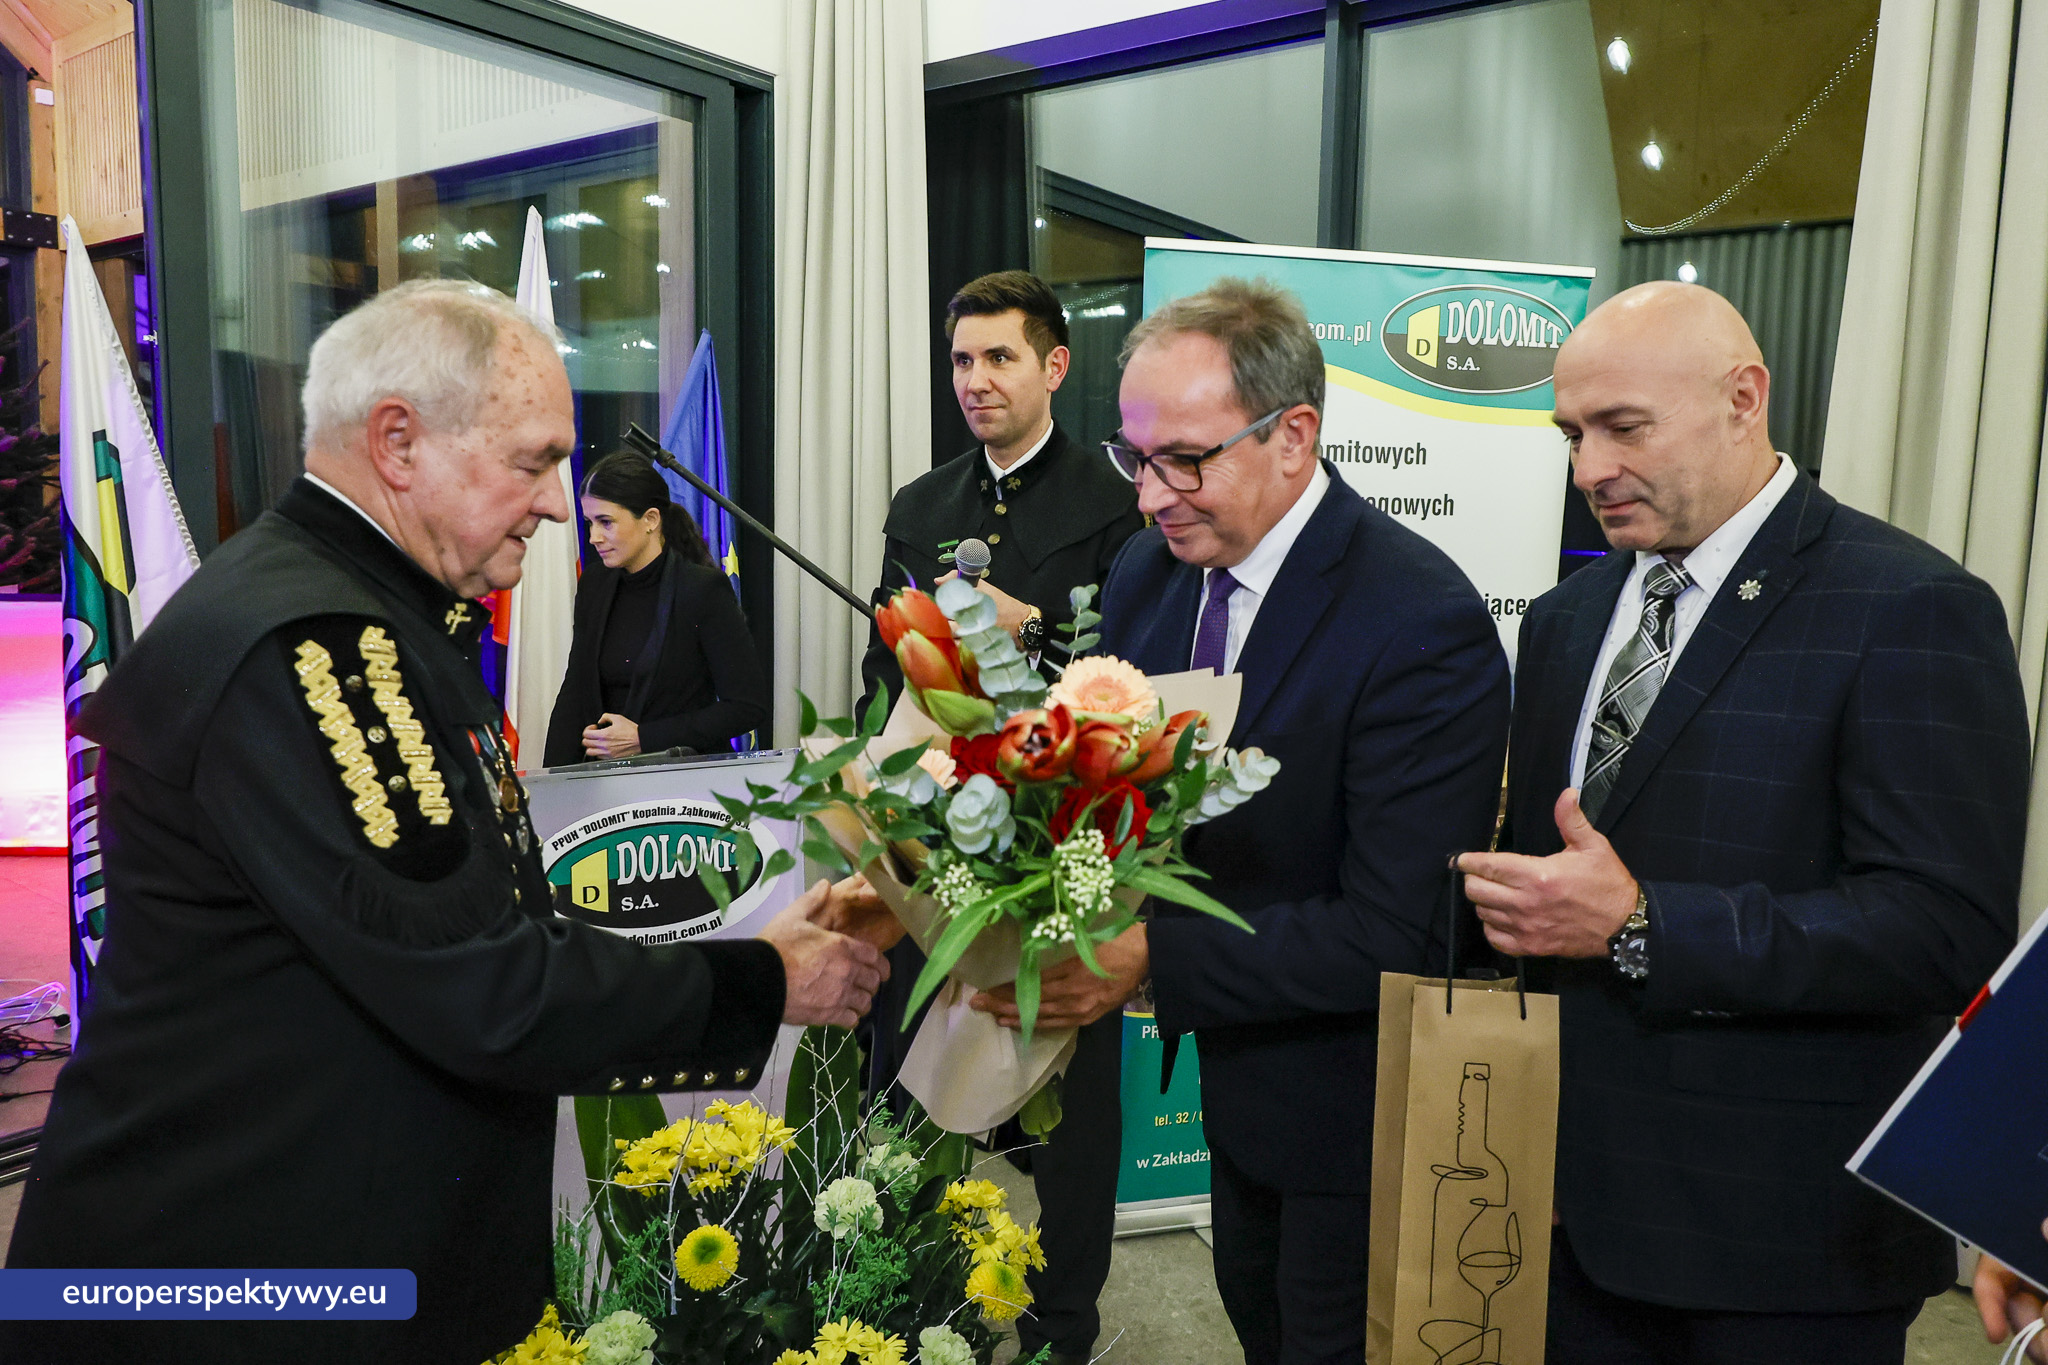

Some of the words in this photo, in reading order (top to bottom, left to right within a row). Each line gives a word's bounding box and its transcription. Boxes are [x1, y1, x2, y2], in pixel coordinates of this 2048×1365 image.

[1445, 298, 1564, 349] DOLOMIT
[1415, 338, 1431, 357] D
[1446, 355, 1481, 371] S.A.
[1361, 493, 1455, 521] ogowych
[551, 830, 580, 851] PPUH
[632, 806, 676, 820] Kopalnia
[616, 833, 738, 886] DOLOMI
[582, 885, 600, 905] D
[621, 894, 660, 912] S.A.
[1154, 1113, 1173, 1127] tel.
[1175, 1111, 1189, 1124] 32
[1136, 1158, 1150, 1169] w
